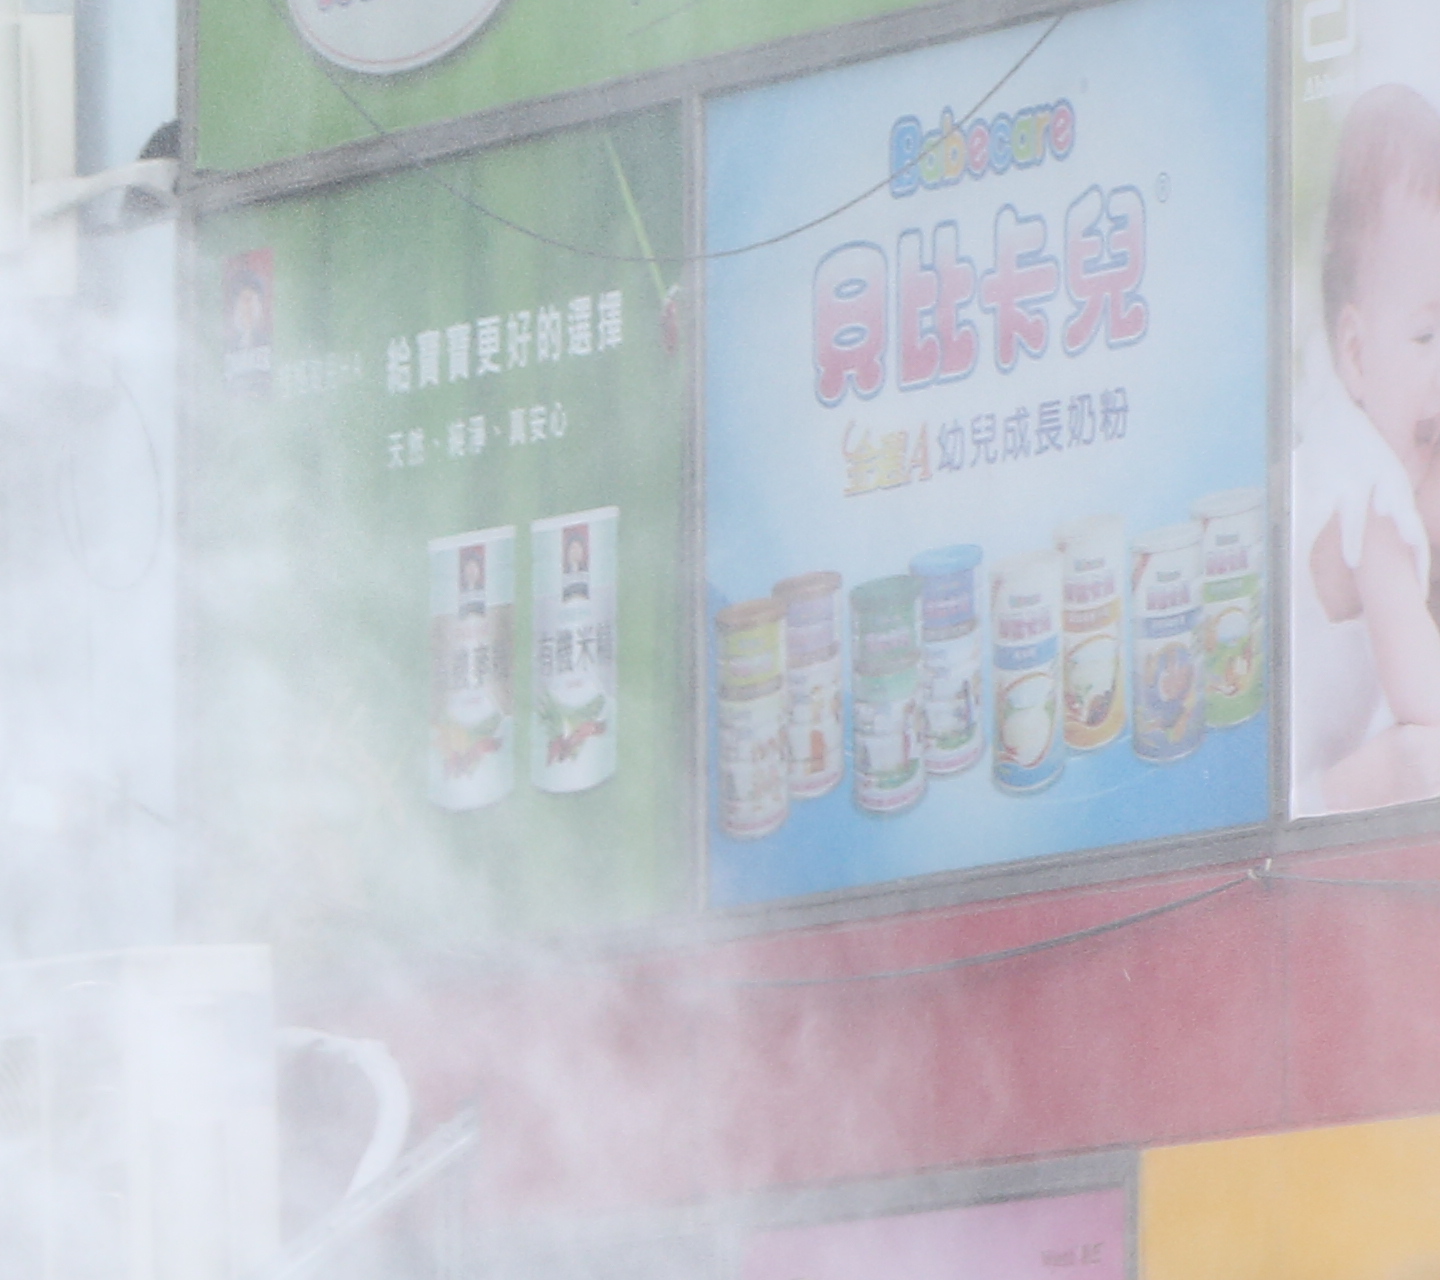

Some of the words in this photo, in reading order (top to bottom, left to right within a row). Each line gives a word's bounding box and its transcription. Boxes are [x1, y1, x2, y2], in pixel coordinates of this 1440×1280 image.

[890, 98, 1075, 200] Babecare
[386, 290, 623, 396] 給寶寶更好的選擇
[813, 183, 1150, 408] 貝比卡兒
[936, 387, 1128, 473] 幼兒成長奶粉
